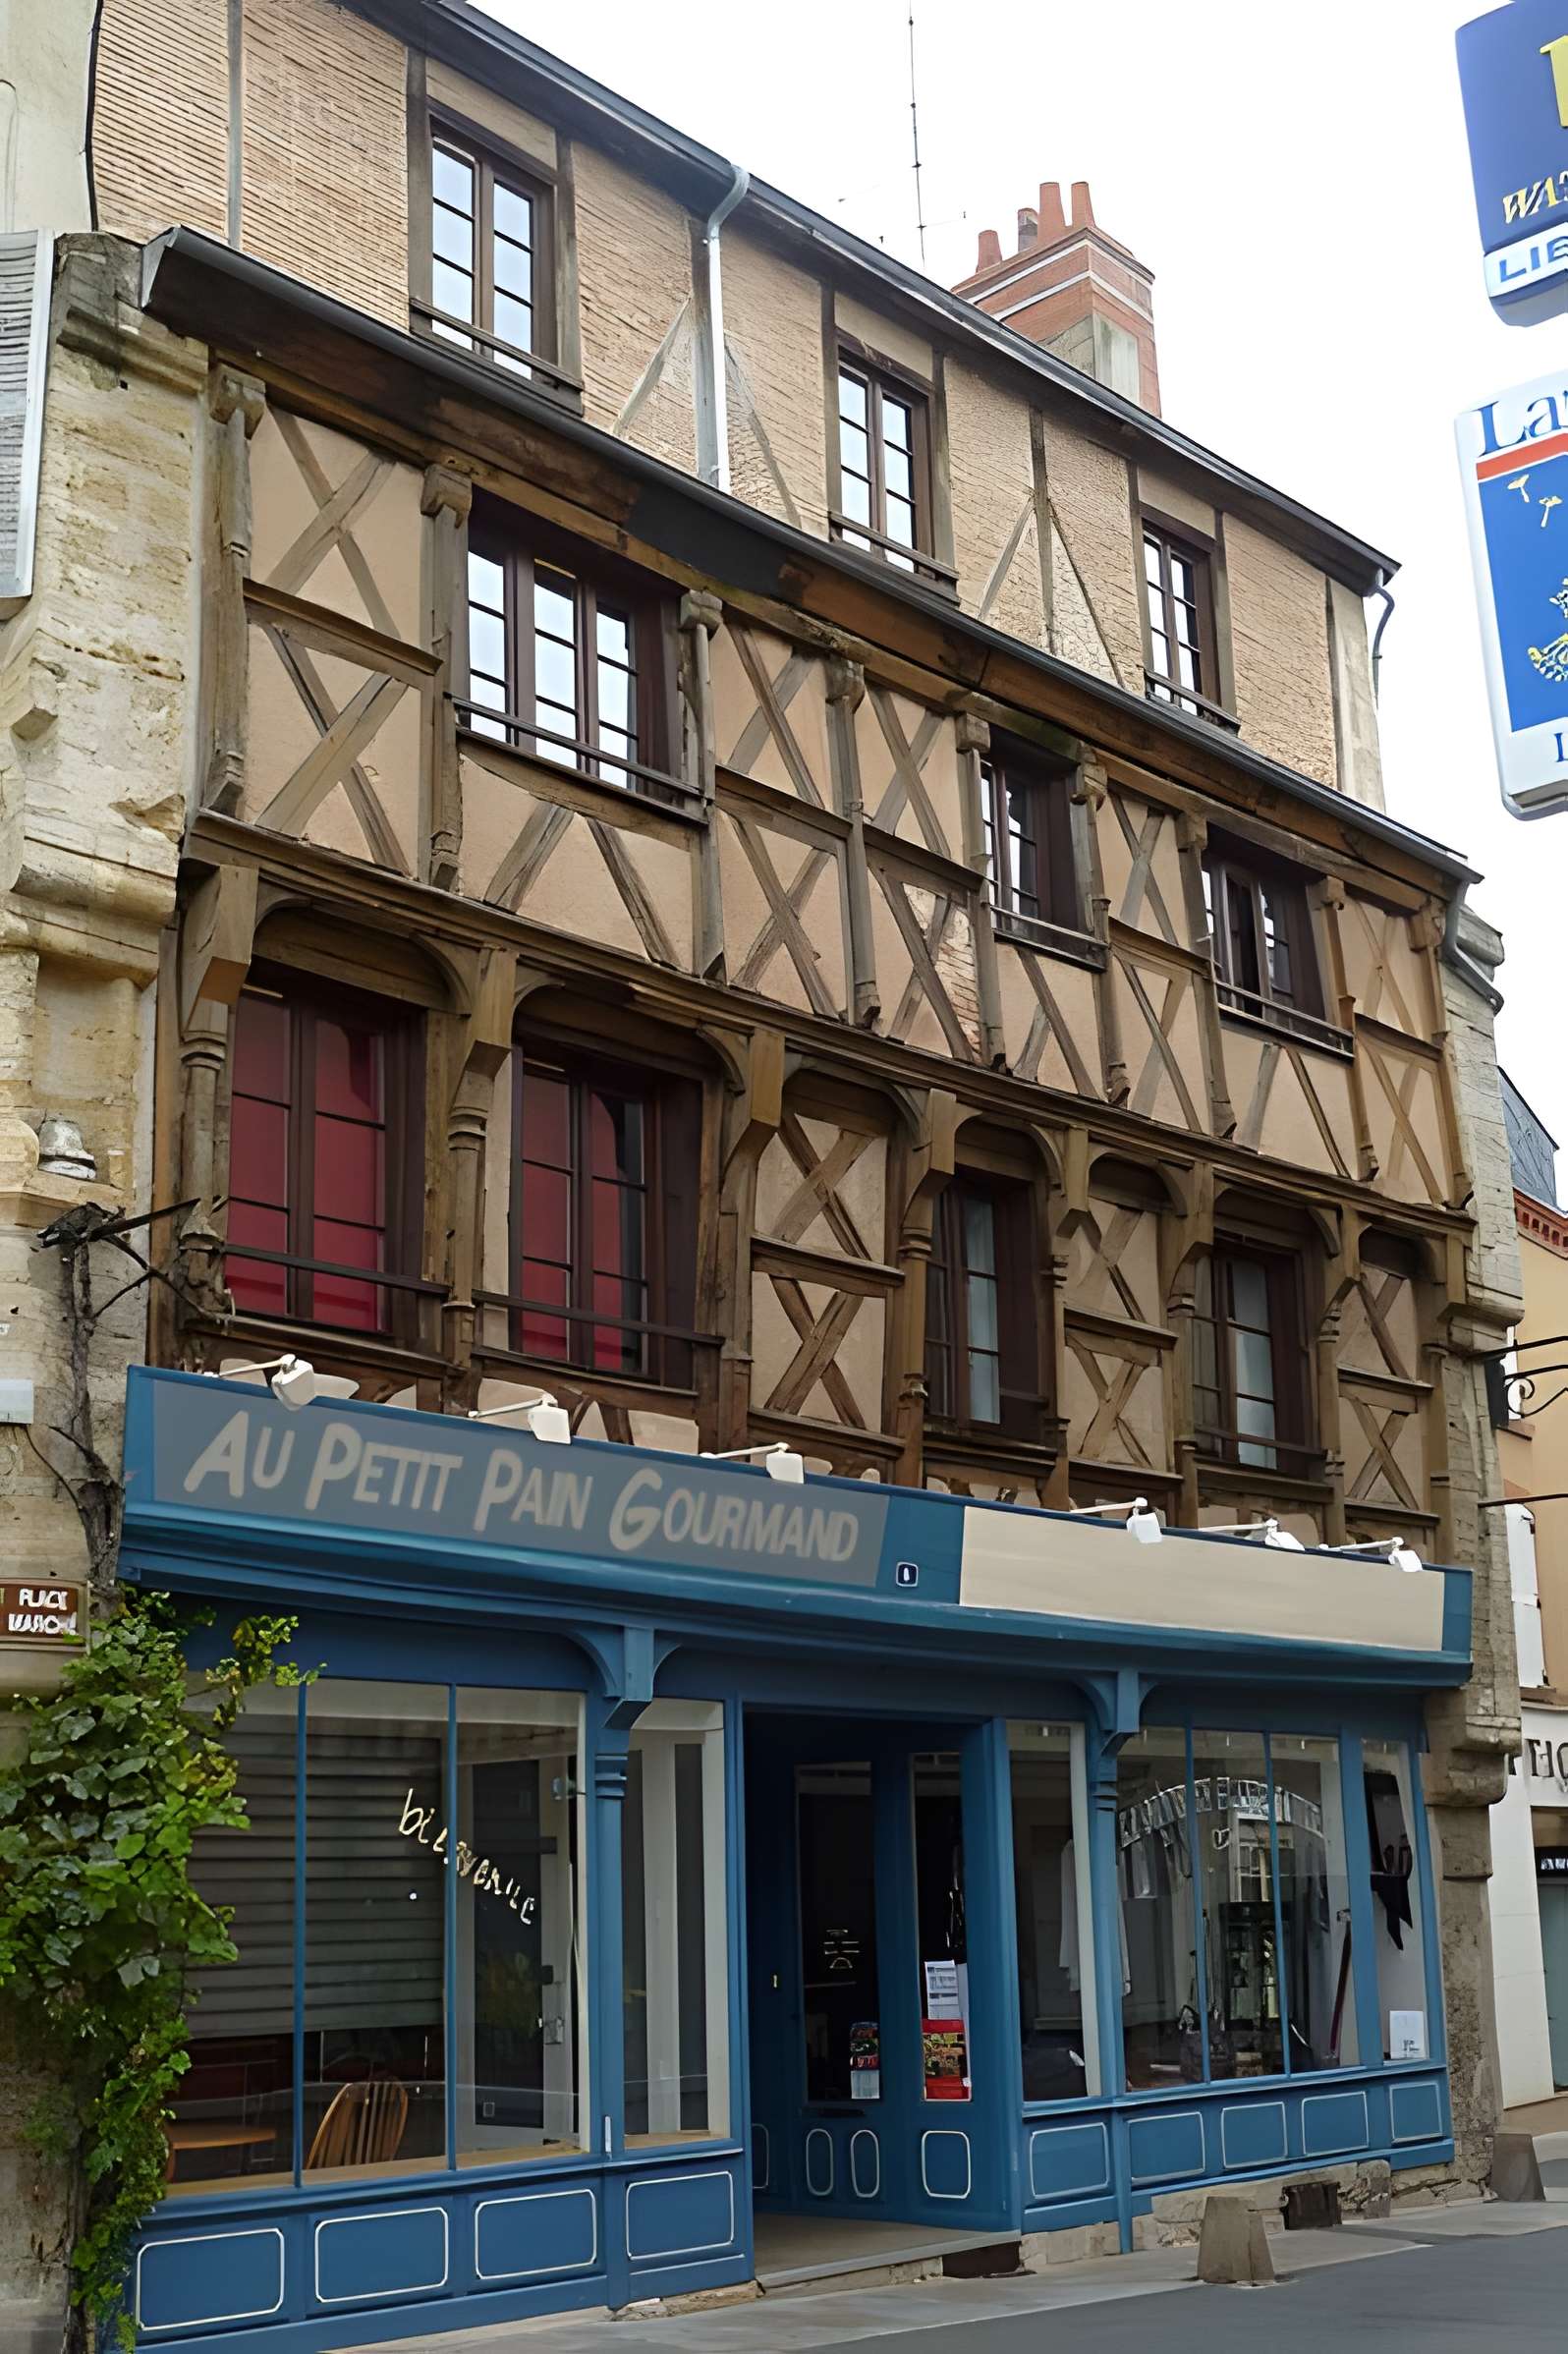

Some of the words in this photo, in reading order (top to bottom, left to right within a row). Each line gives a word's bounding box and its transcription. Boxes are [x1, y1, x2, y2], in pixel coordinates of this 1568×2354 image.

[184, 1411, 295, 1498] AU
[304, 1423, 464, 1510] PETIT
[474, 1448, 594, 1533] PAIN
[609, 1468, 859, 1562] GOURMAND
